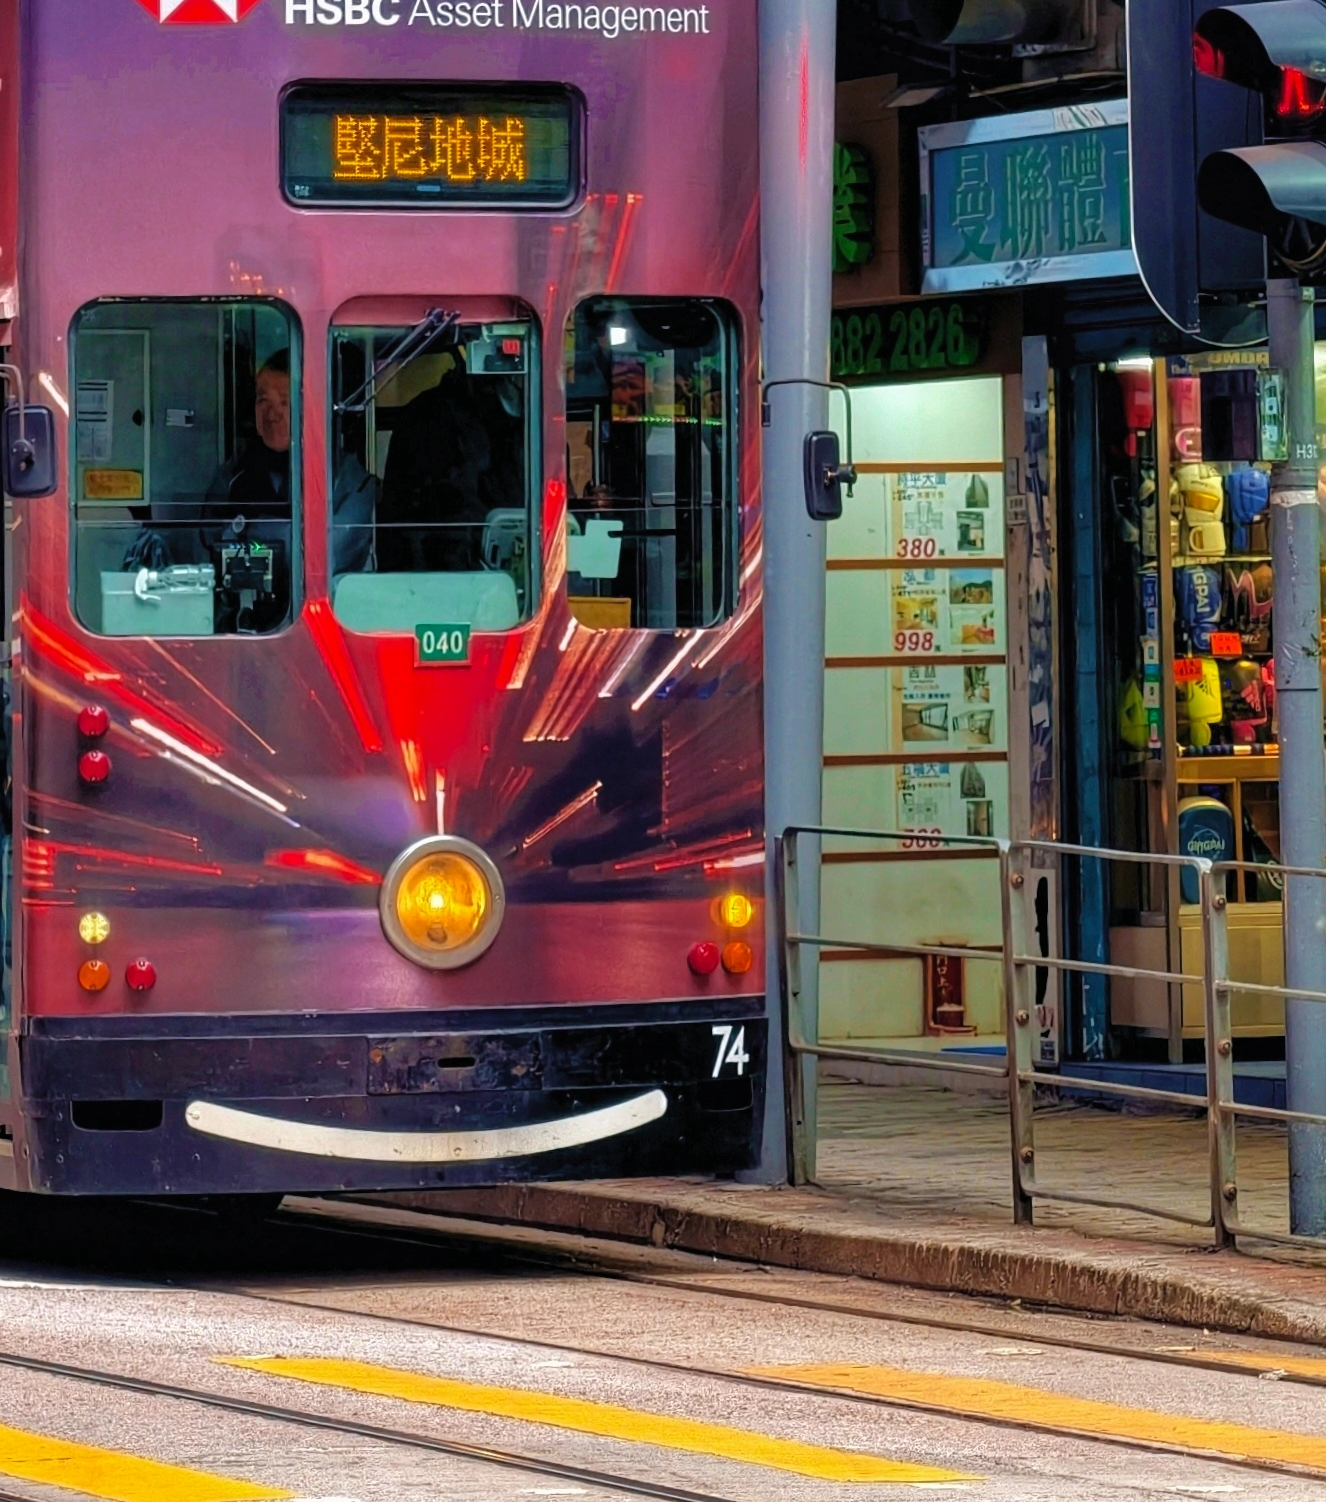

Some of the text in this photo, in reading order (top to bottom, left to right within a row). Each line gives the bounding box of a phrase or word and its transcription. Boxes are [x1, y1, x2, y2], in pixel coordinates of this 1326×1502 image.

[334, 114, 525, 182] 堅尼地城
[897, 538, 936, 558] 380
[423, 631, 463, 654] 040
[895, 632, 933, 652] 998
[712, 1026, 749, 1077] 74
